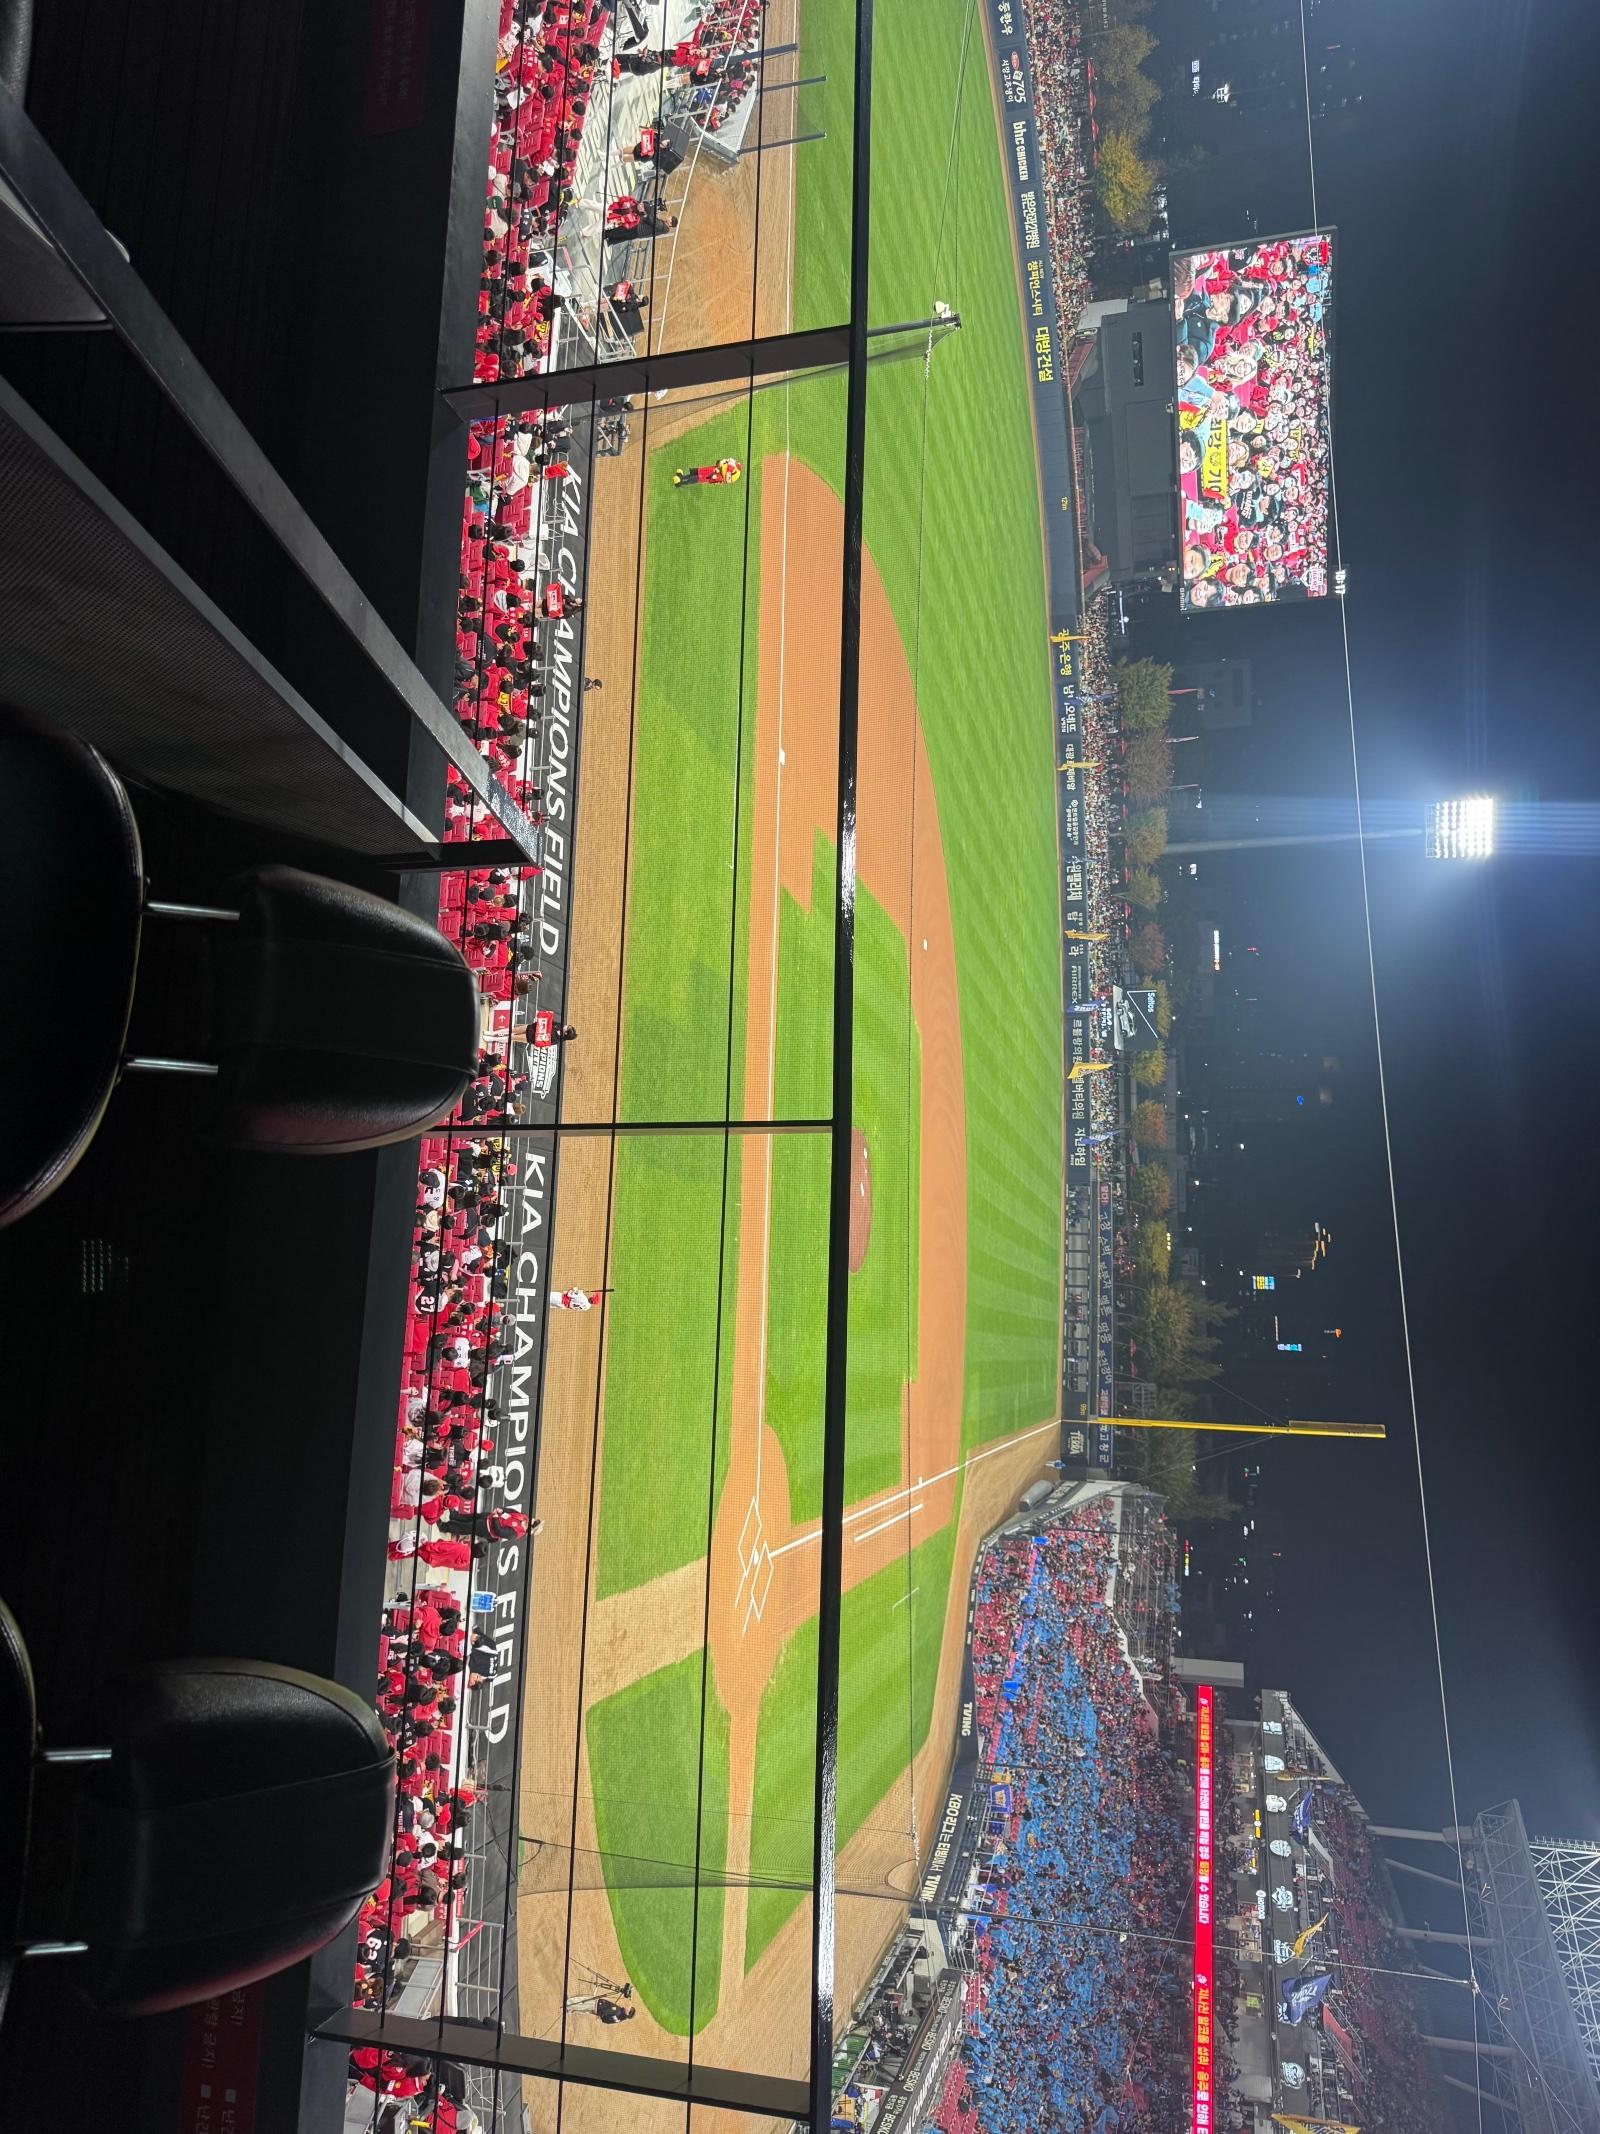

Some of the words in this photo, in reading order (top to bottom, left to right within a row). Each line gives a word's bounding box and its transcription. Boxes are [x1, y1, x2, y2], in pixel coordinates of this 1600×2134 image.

[1002, 59, 1015, 103] 서양고추냉이
[1012, 81, 1026, 104] 705
[1013, 121, 1026, 146] bhc
[1016, 146, 1028, 181] CHICKEN
[1020, 191, 1042, 250] 밝은안과21병원
[1027, 260, 1042, 316] 챔피언스시티
[1035, 326, 1054, 382] 대방건설
[560, 464, 582, 541] KIA
[539, 825, 566, 956] FIELD
[520, 1152, 546, 1234] KIA
[420, 1296, 434, 1312] 27
[1070, 1430, 1080, 1454] TERRA
[464, 1500, 472, 1512] 117
[484, 1590, 516, 1744] FIELD
[960, 1702, 973, 1736] TVING
[919, 1874, 941, 1902] TVING
[1199, 1884, 1209, 1892] 수
[1198, 1988, 1210, 2014] 지나친
[920, 2031, 937, 2050] BESKO
[902, 2070, 920, 2092] BESKO
[1196, 2104, 1209, 2126] 인해
